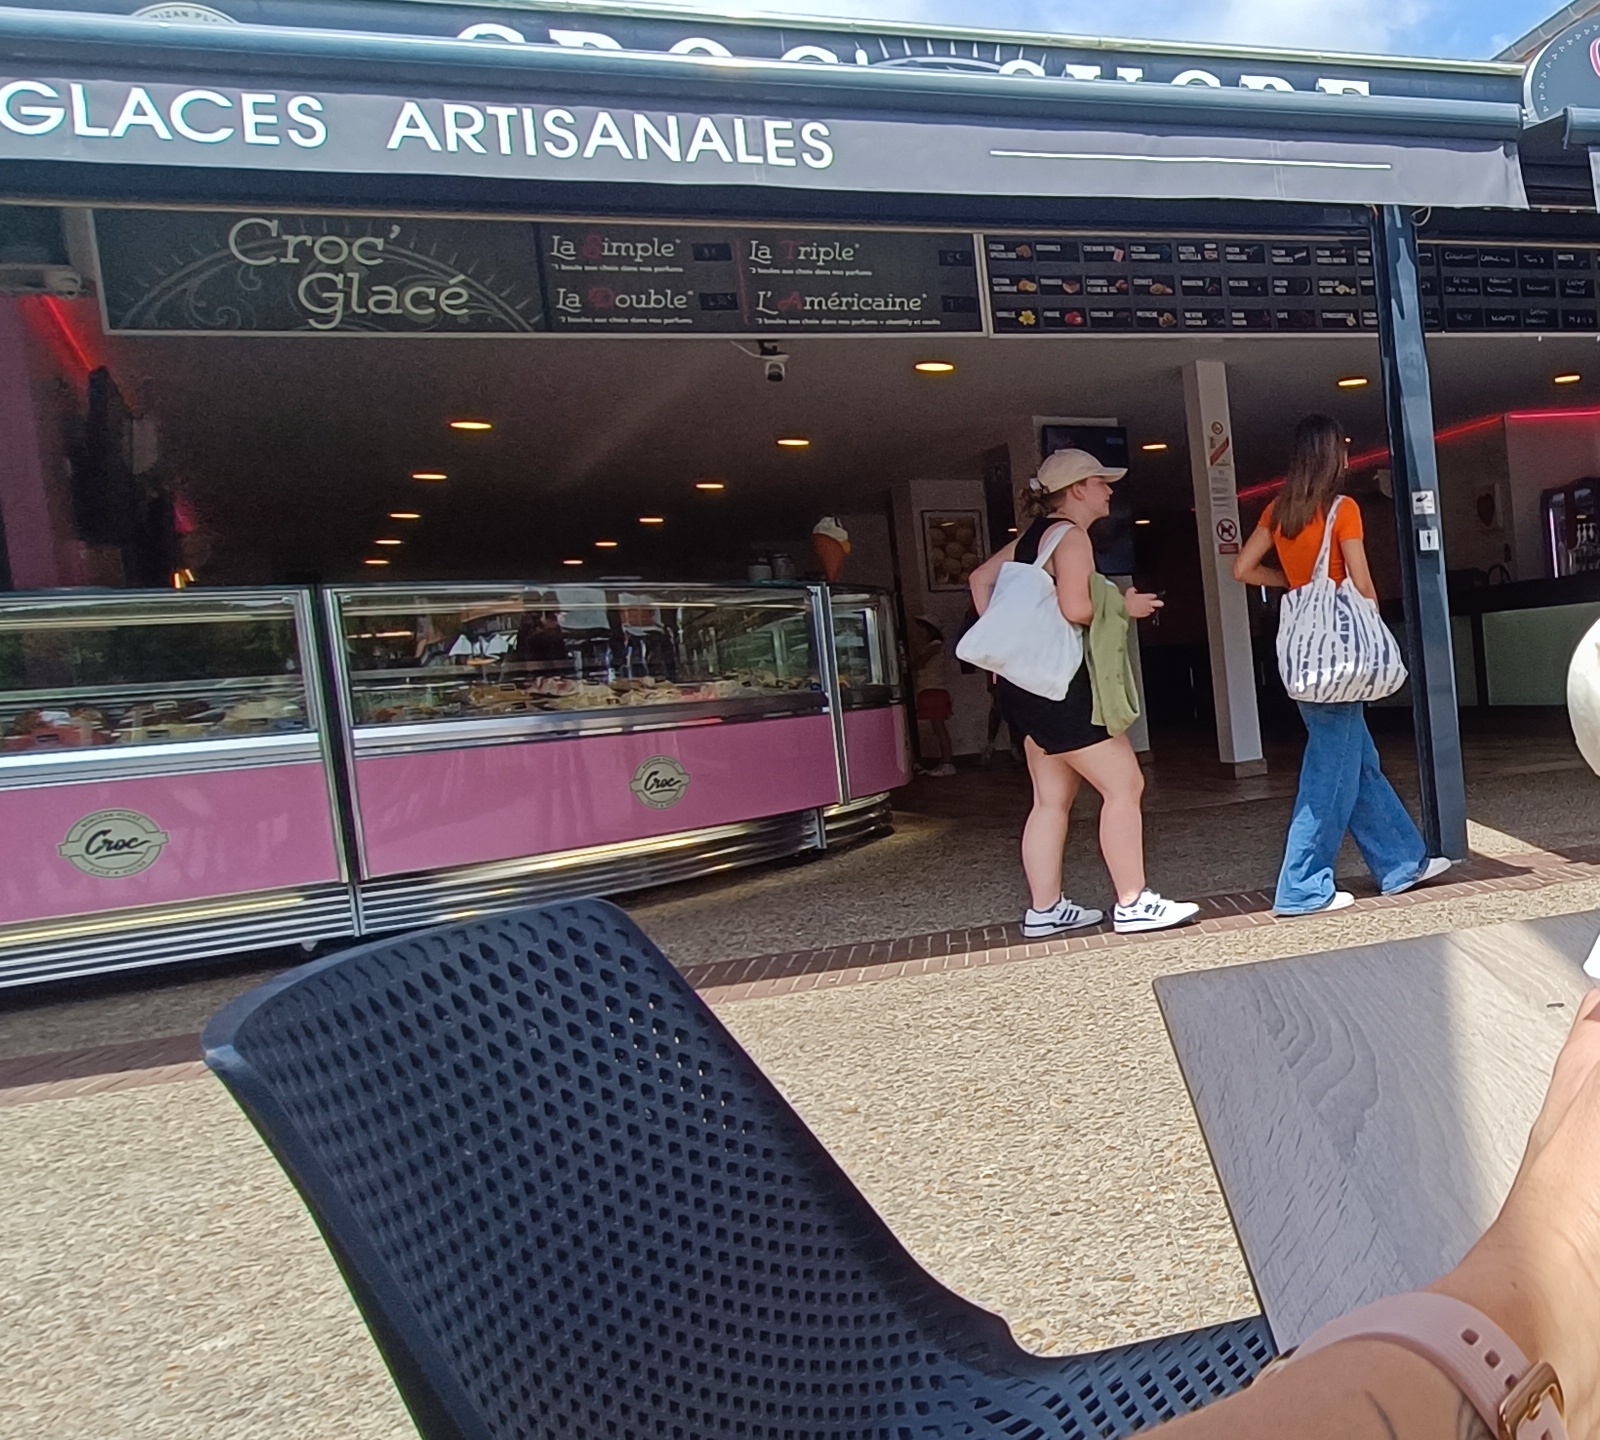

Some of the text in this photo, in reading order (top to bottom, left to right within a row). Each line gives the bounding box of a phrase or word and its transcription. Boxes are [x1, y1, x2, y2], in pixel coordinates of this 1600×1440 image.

[0, 80, 835, 170] GLACES ARTISANALES
[228, 217, 402, 266] Croc'
[298, 272, 470, 330] Glacé
[643, 769, 682, 792] Croc
[84, 828, 152, 856] Croc
